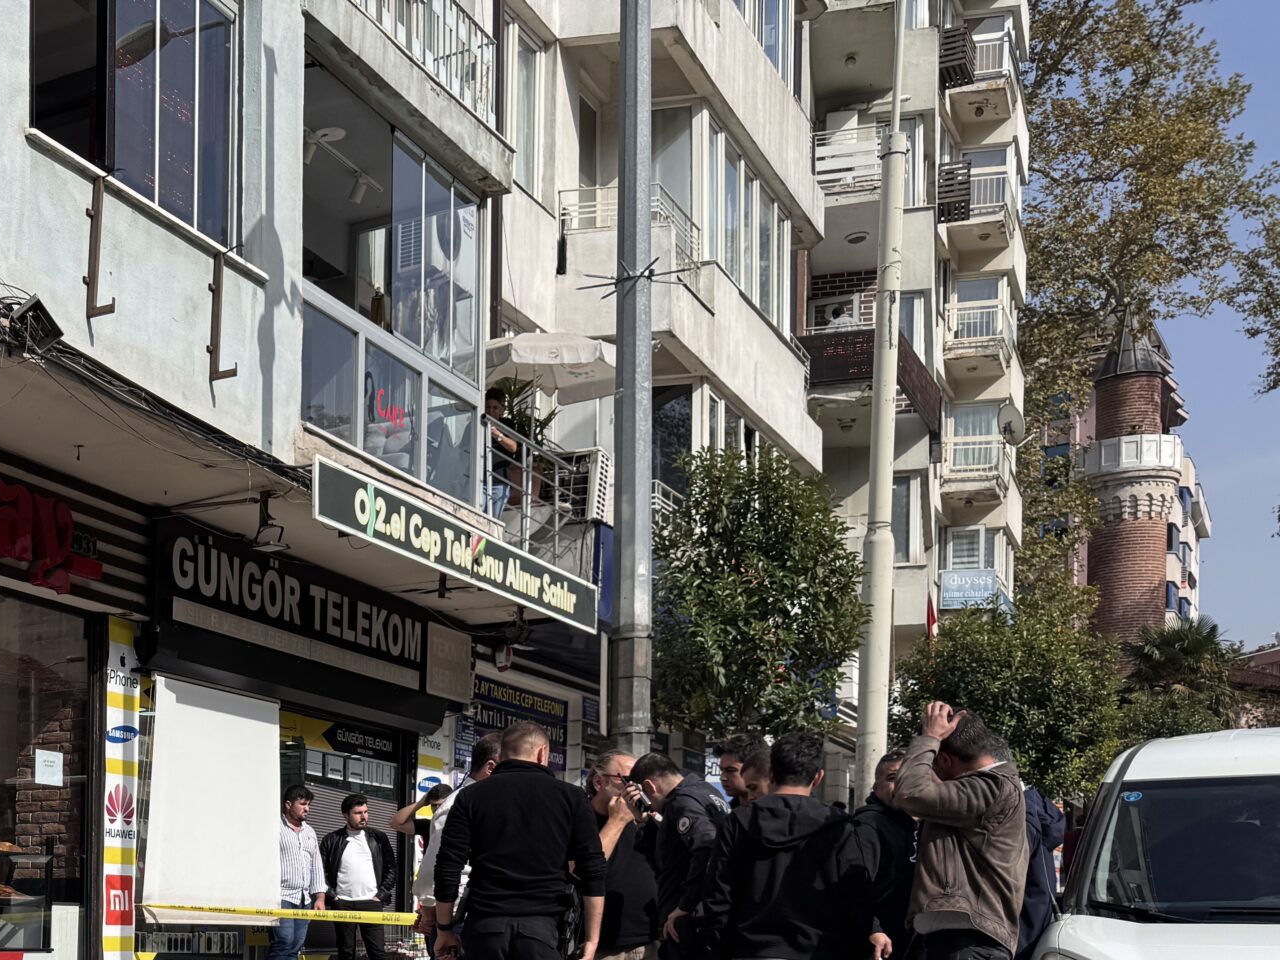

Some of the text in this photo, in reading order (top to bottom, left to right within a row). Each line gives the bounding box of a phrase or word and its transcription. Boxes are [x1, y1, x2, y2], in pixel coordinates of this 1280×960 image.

[72, 532, 99, 558] 931
[375, 496, 406, 542] 2.el
[409, 513, 441, 562] Cep
[443, 527, 504, 583] Teleonu
[505, 557, 541, 598] Alınır
[542, 574, 577, 614] Satılır
[950, 574, 993, 587] duyses
[172, 535, 421, 663] GÜNGÖR TELEKOM
[223, 615, 238, 632] VE
[107, 669, 138, 689] iPhone
[479, 681, 489, 695] AY
[490, 682, 520, 705] TAKSİTLE
[520, 692, 534, 709] CEP
[534, 696, 564, 718] TELEFONU
[108, 729, 135, 740] SAMSUNG
[475, 704, 505, 729] ANTİLİ
[545, 723, 564, 743] ERVİS
[337, 728, 393, 752] GÜNGÖR TELEKOM
[105, 828, 136, 840] HUAWEI
